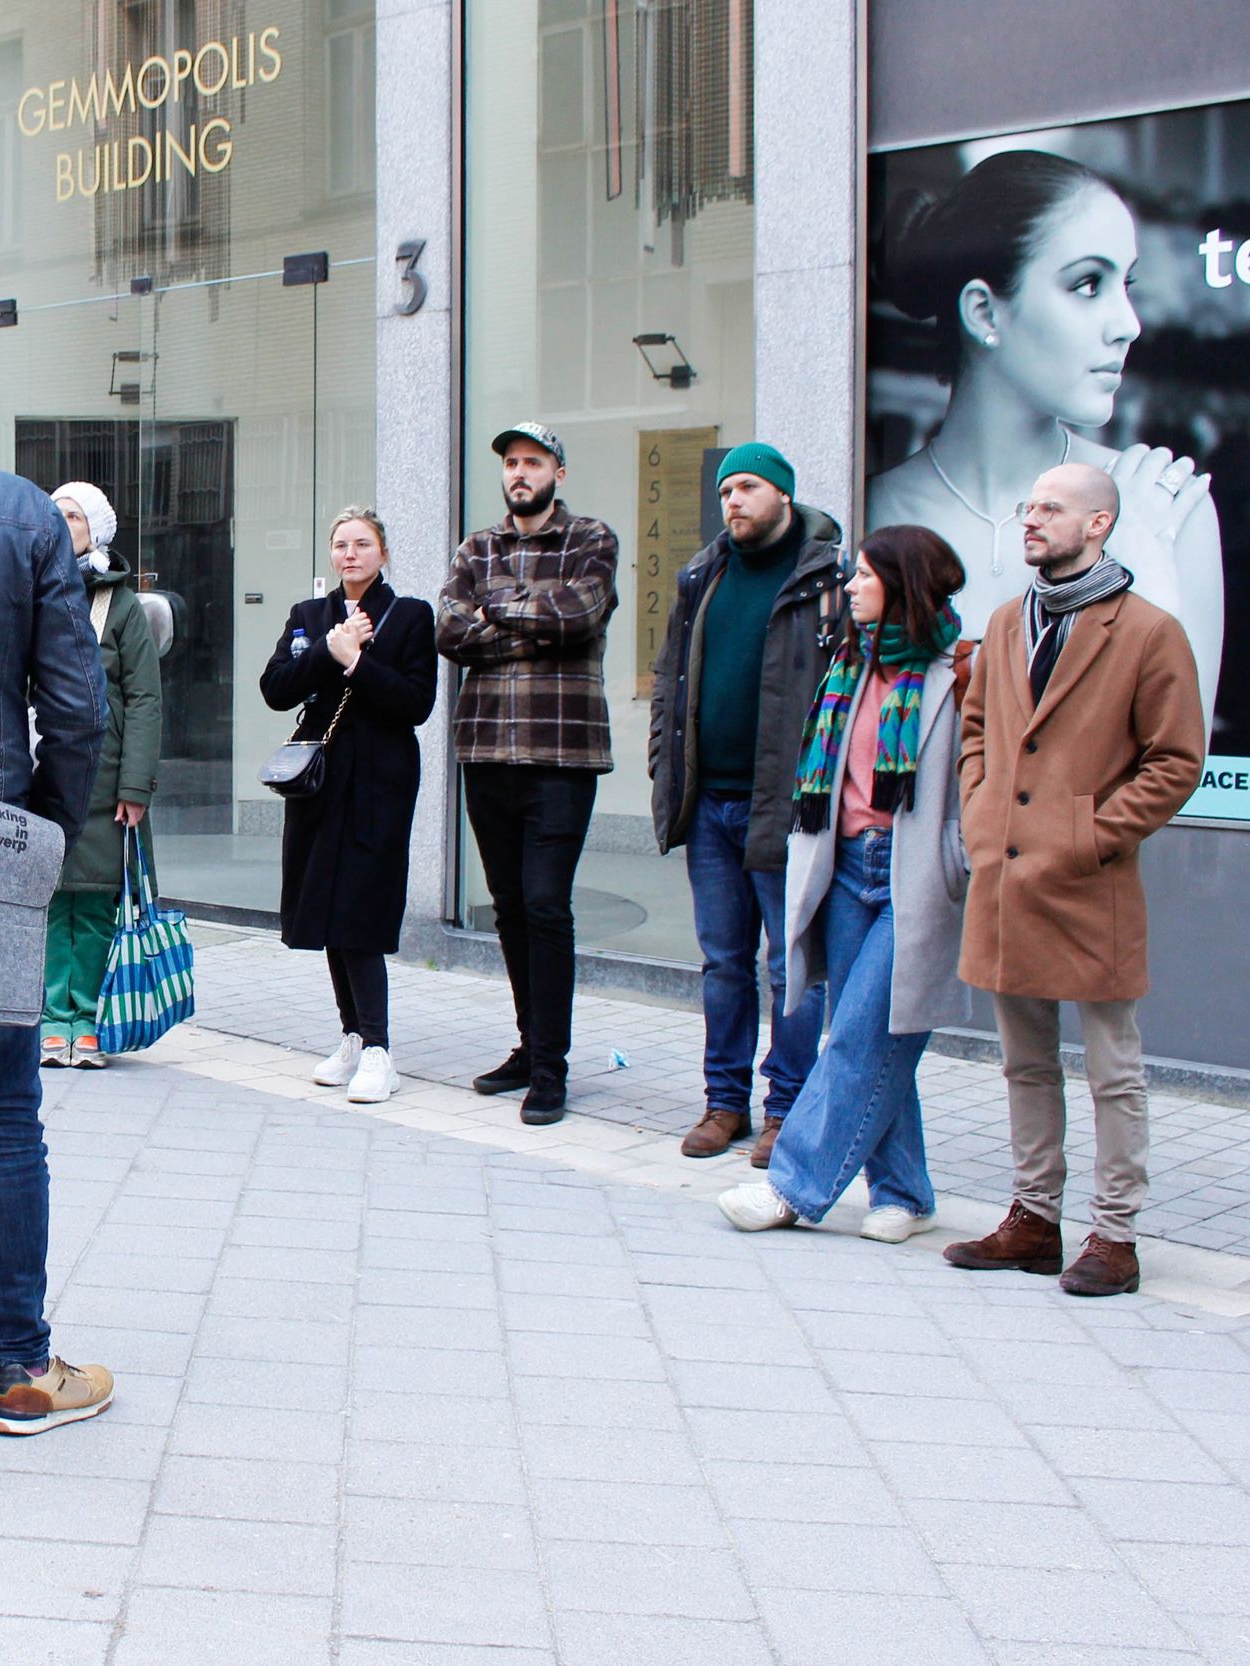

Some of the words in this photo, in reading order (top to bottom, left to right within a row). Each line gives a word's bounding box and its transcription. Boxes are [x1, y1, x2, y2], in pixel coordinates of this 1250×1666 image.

[17, 26, 282, 137] GEMMOPOLIS
[56, 117, 233, 202] BUILDING
[395, 238, 428, 317] 3
[648, 444, 661, 467] 6
[648, 480, 661, 504] 5
[647, 519, 660, 541] 4
[648, 554, 660, 577] 3
[647, 591, 660, 614] 2
[648, 627, 655, 650] 1
[1198, 770, 1249, 790] ACE
[15, 826, 29, 840] in
